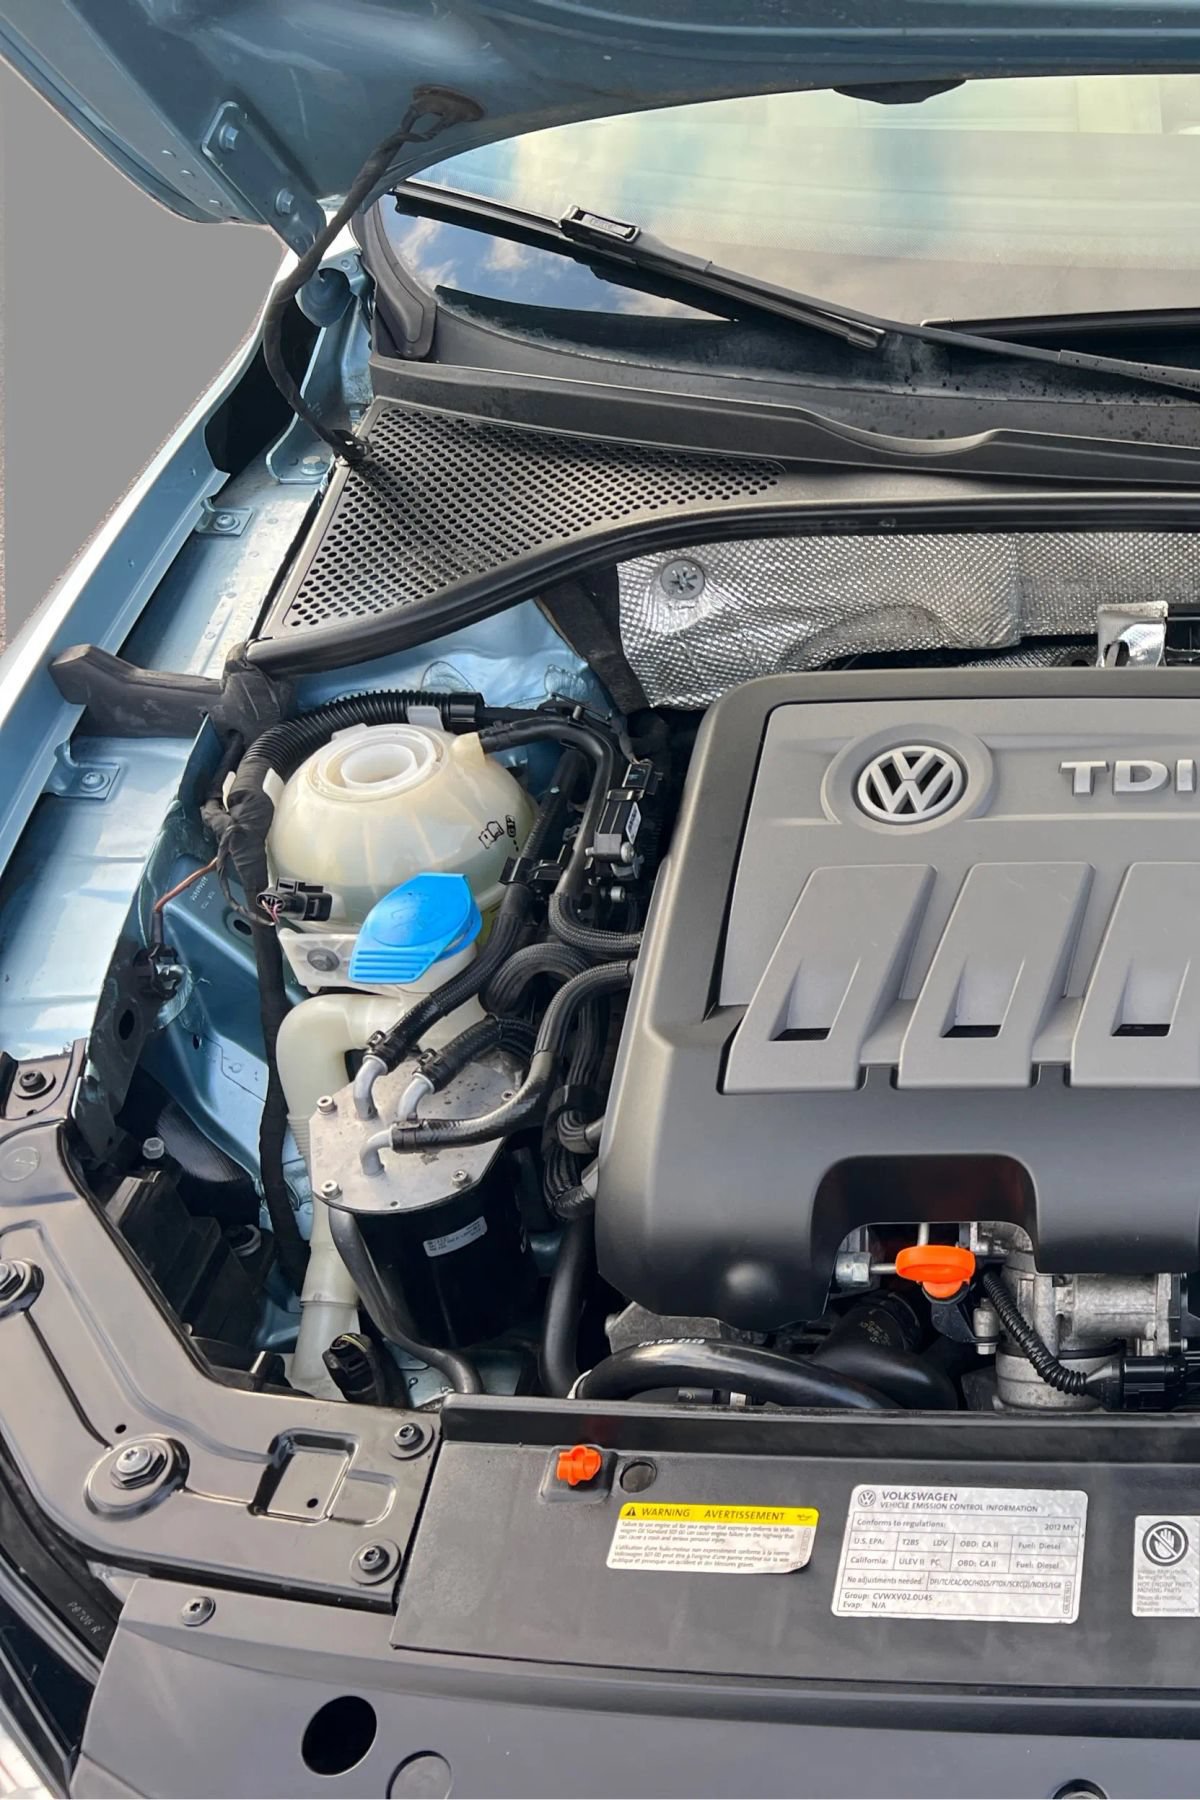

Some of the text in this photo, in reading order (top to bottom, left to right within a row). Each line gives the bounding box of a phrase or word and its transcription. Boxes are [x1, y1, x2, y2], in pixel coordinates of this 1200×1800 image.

[1059, 758, 1197, 796] TDI
[881, 1491, 957, 1501] VOLKSWAGEN
[641, 1508, 785, 1520] WARNING AVERTISSEMENT
[857, 1576, 896, 1585] adjustments
[844, 1592, 869, 1600] Group:
